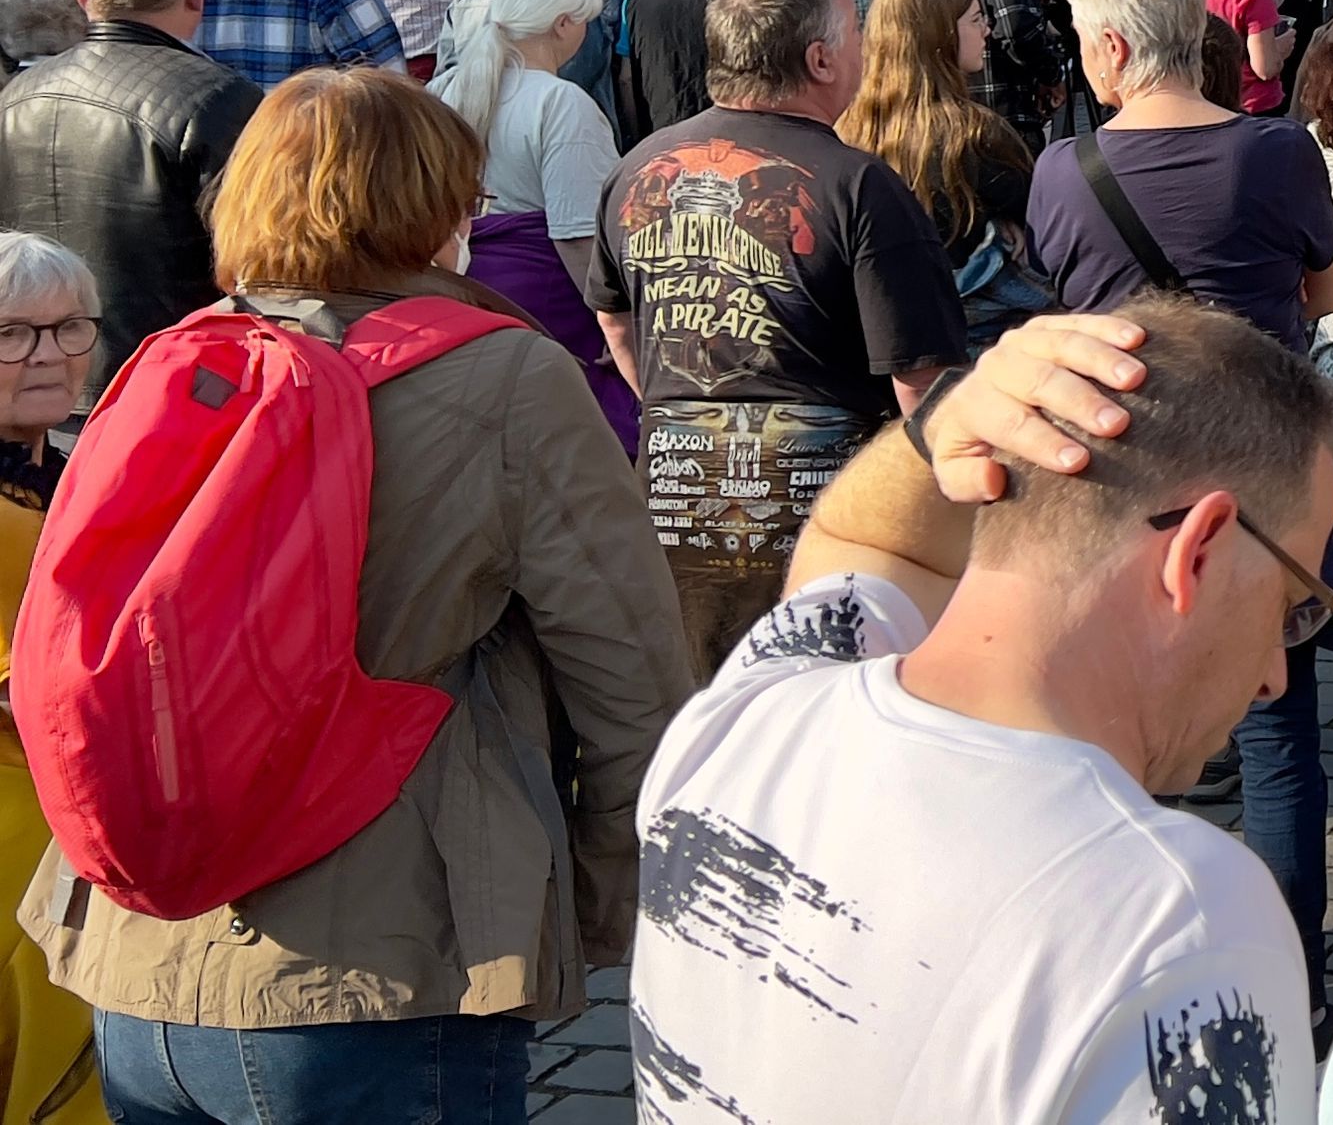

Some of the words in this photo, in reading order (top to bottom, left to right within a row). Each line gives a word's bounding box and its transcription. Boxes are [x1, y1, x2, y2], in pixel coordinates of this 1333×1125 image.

[628, 218, 667, 258] FULL
[670, 213, 730, 262] METAL
[731, 226, 784, 277] CRUISE
[644, 276, 721, 303] MEAN
[726, 287, 767, 314] AS
[652, 307, 667, 334] A
[672, 303, 781, 346] PIRATE
[648, 427, 714, 455] SAXON
